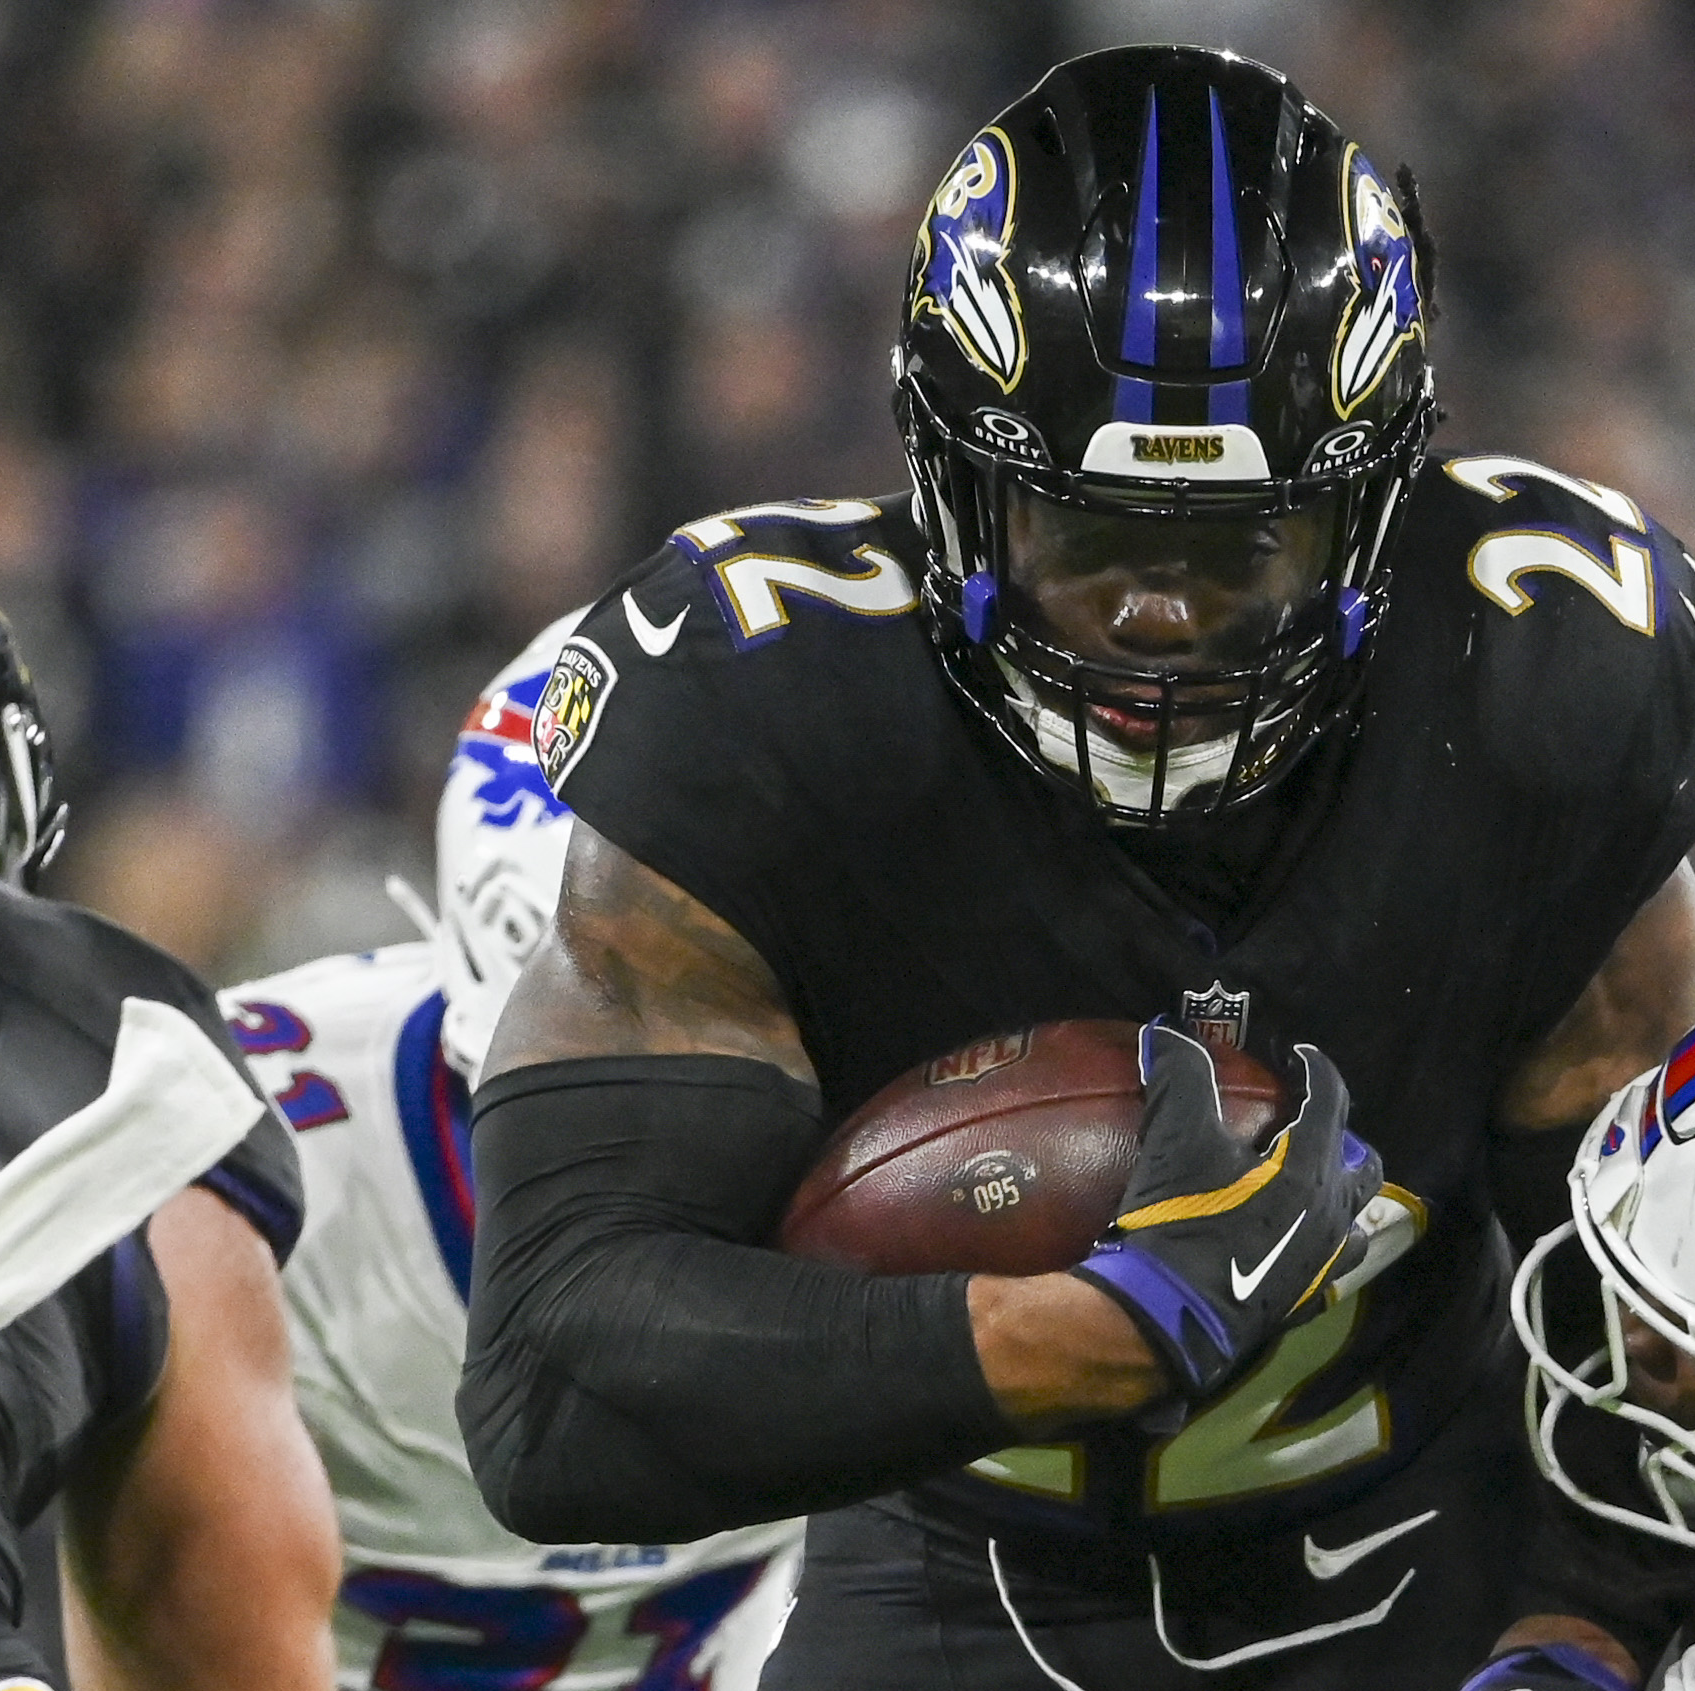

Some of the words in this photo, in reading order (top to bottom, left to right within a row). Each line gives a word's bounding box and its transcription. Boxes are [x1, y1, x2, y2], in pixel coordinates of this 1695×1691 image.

[975, 426, 1040, 459] OAKLEY
[1129, 433, 1224, 463] RAVENS
[1311, 443, 1371, 473] OAKLEY
[1442, 454, 1656, 638] 22
[674, 497, 921, 640] 22
[559, 648, 602, 689] RAVENS
[935, 1037, 1018, 1080] NFL
[974, 1175, 1020, 1214] 095
